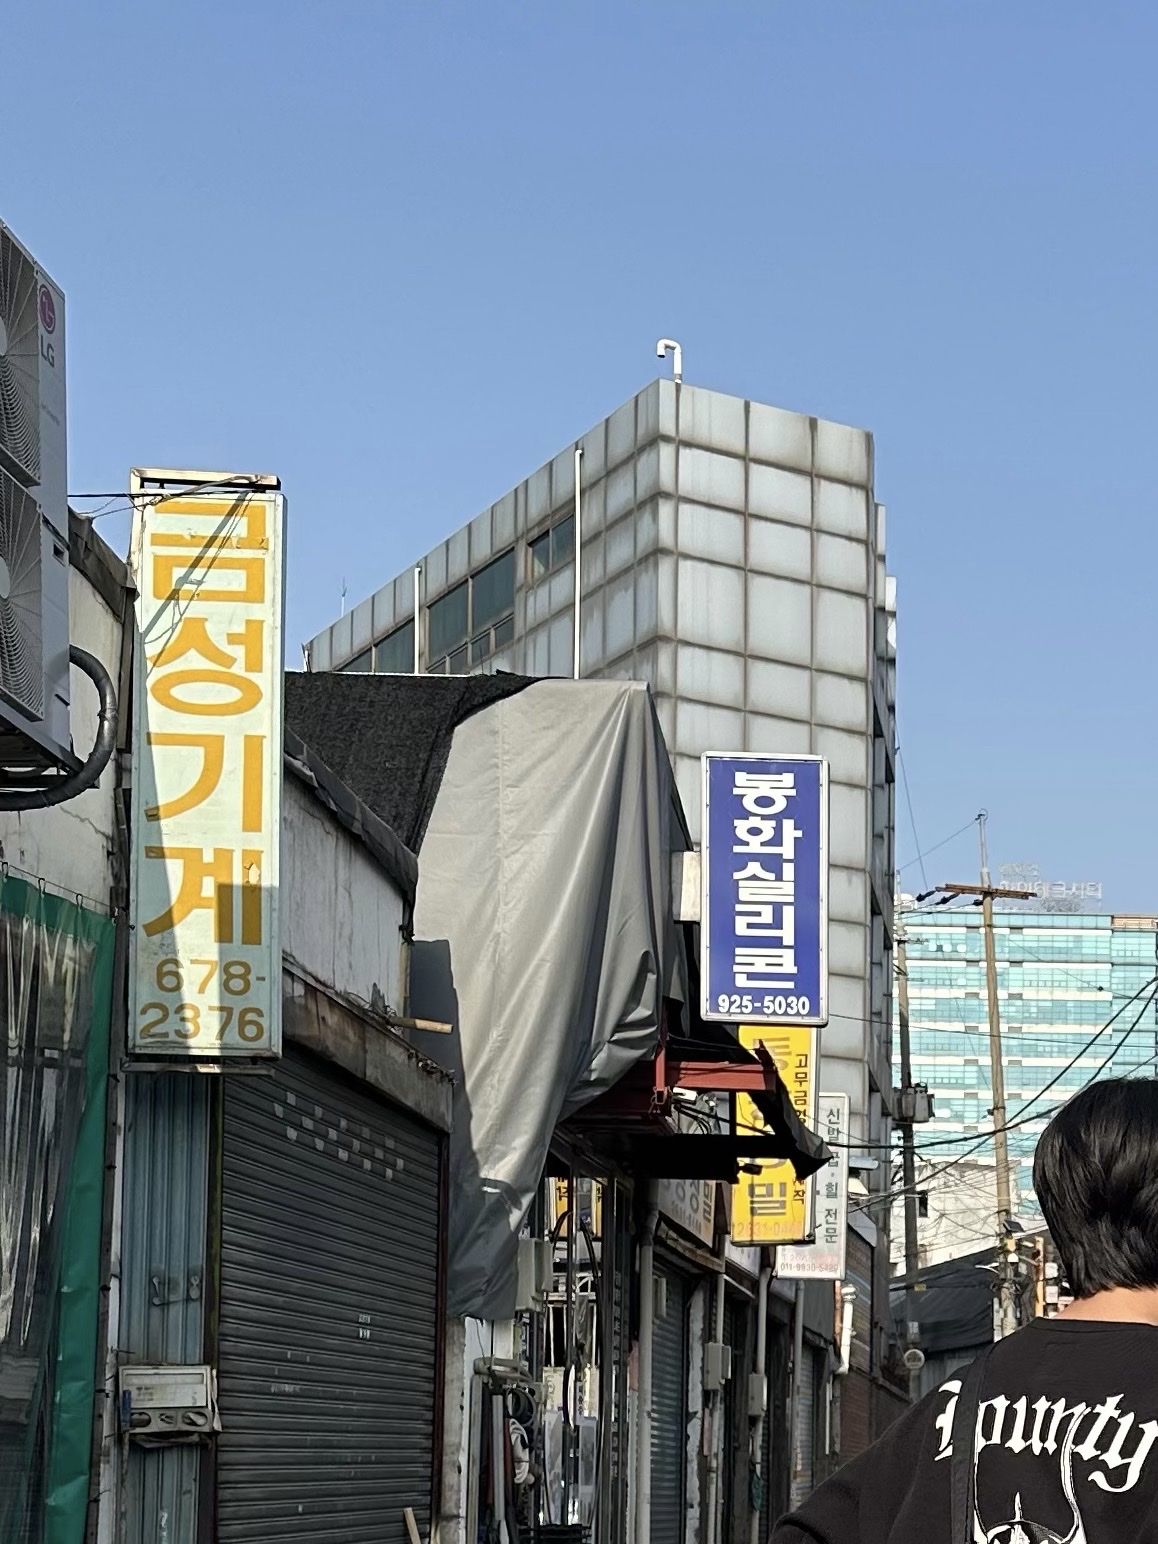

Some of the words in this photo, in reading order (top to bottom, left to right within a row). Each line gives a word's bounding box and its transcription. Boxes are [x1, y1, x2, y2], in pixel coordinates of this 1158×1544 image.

[40, 334, 55, 368] LG
[142, 501, 269, 945] 금성기계
[732, 771, 803, 989] 봉화실리콘
[139, 1002, 265, 1043] 2376
[718, 994, 810, 1015] 925-5030
[823, 1208, 839, 1244] 전문
